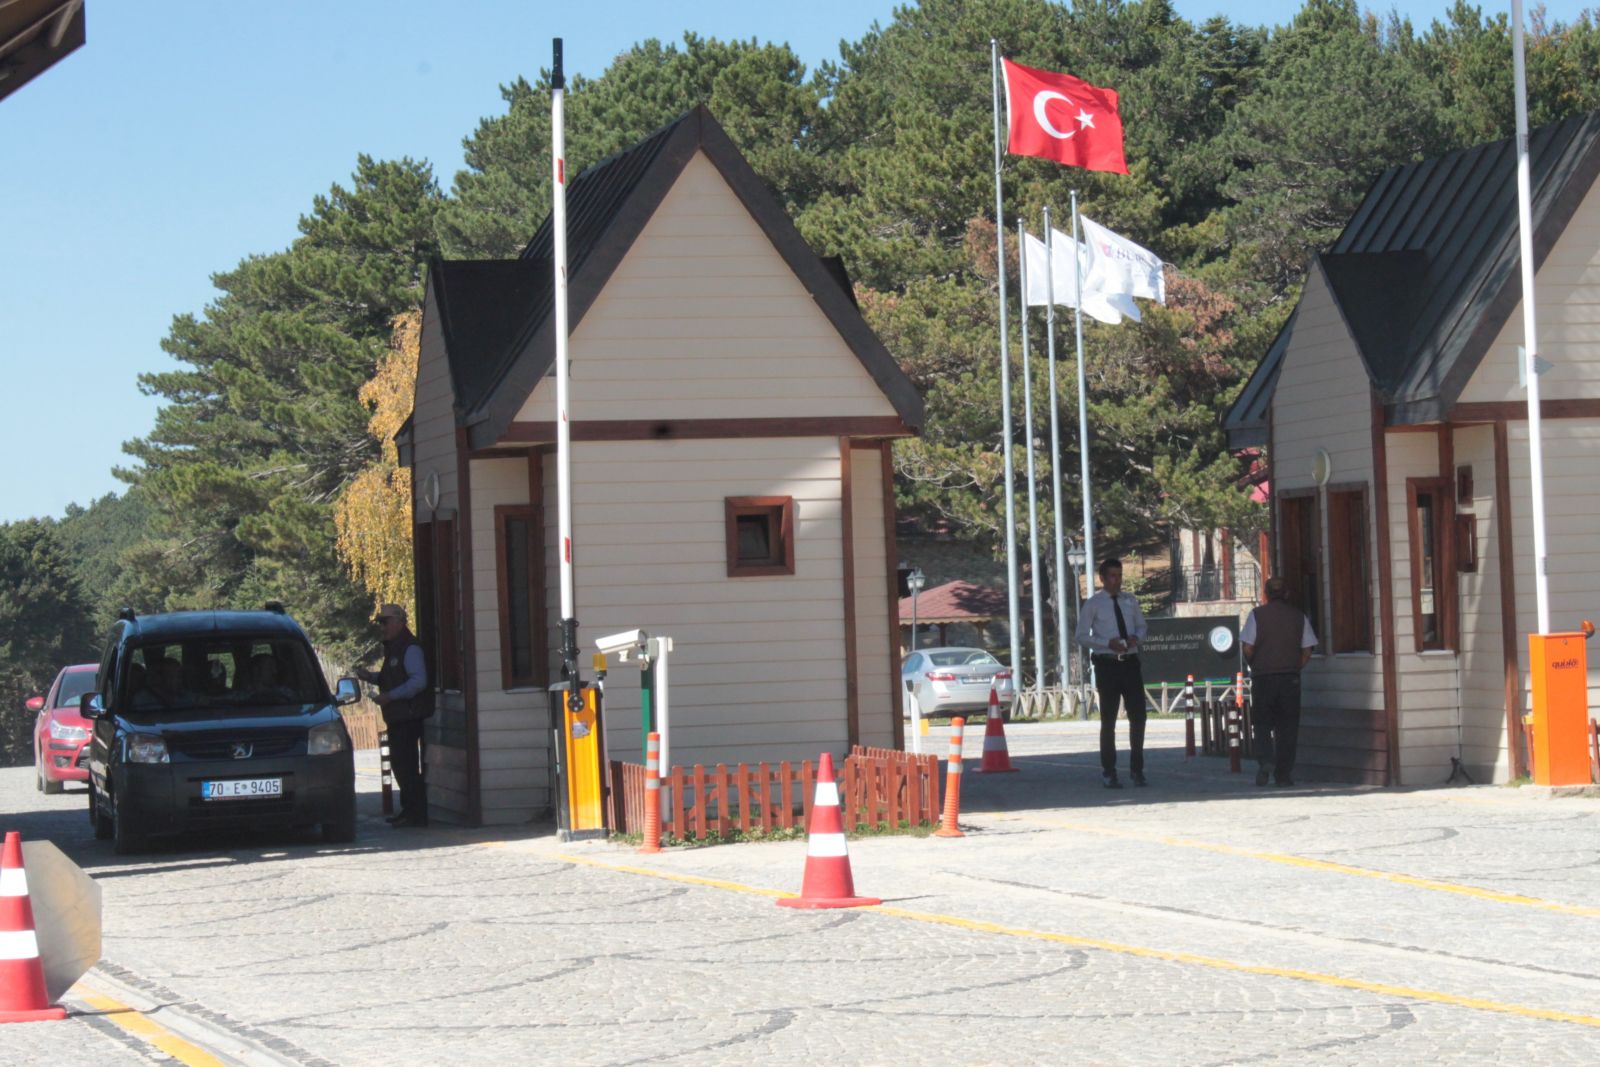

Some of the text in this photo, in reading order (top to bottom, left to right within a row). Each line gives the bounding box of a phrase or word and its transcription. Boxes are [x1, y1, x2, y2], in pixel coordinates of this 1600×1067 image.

[210, 780, 279, 796] 70 E 9405
